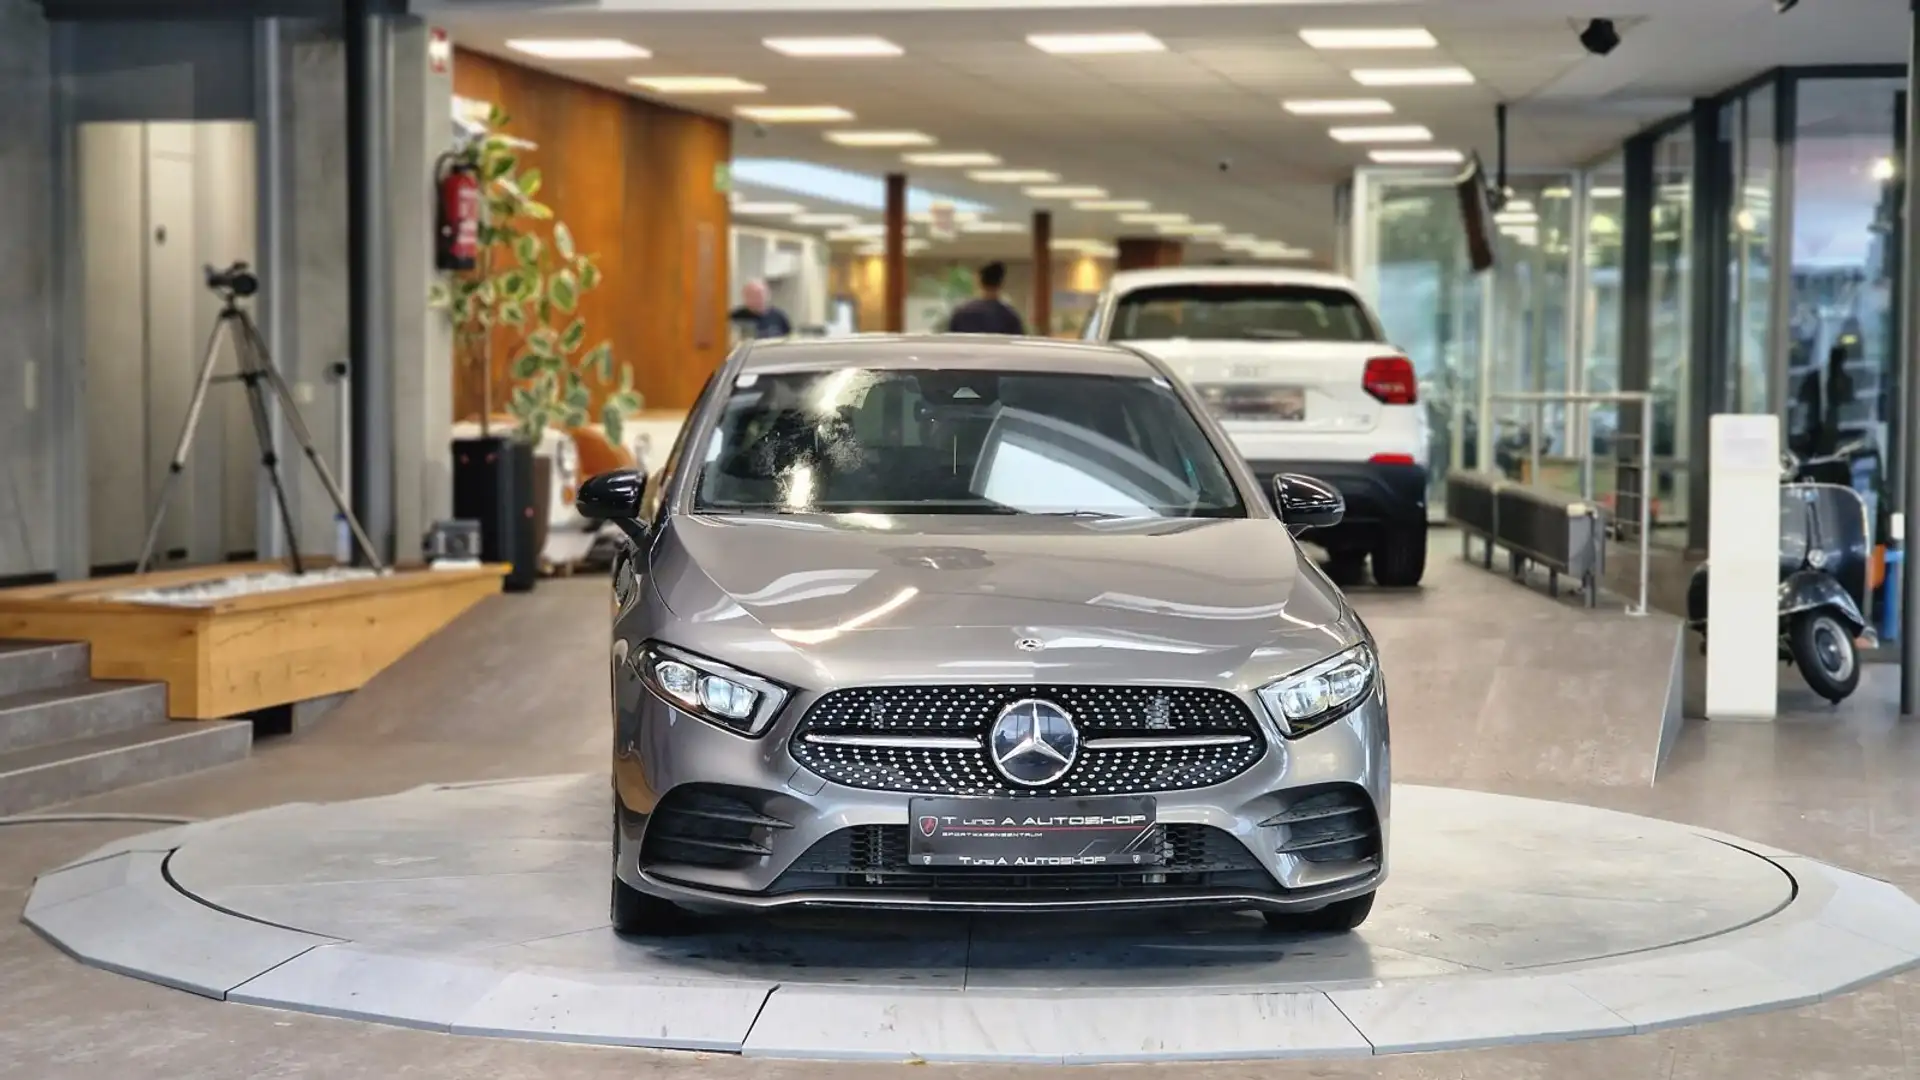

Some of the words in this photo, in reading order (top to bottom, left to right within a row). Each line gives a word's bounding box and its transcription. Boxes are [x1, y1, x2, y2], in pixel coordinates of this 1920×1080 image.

[941, 816, 958, 825] T
[1001, 816, 1017, 826] A
[1022, 815, 1146, 826] AUTOSHOP
[959, 856, 971, 865] T
[996, 856, 1008, 866] A
[1014, 856, 1106, 866] AUTOSHOP
